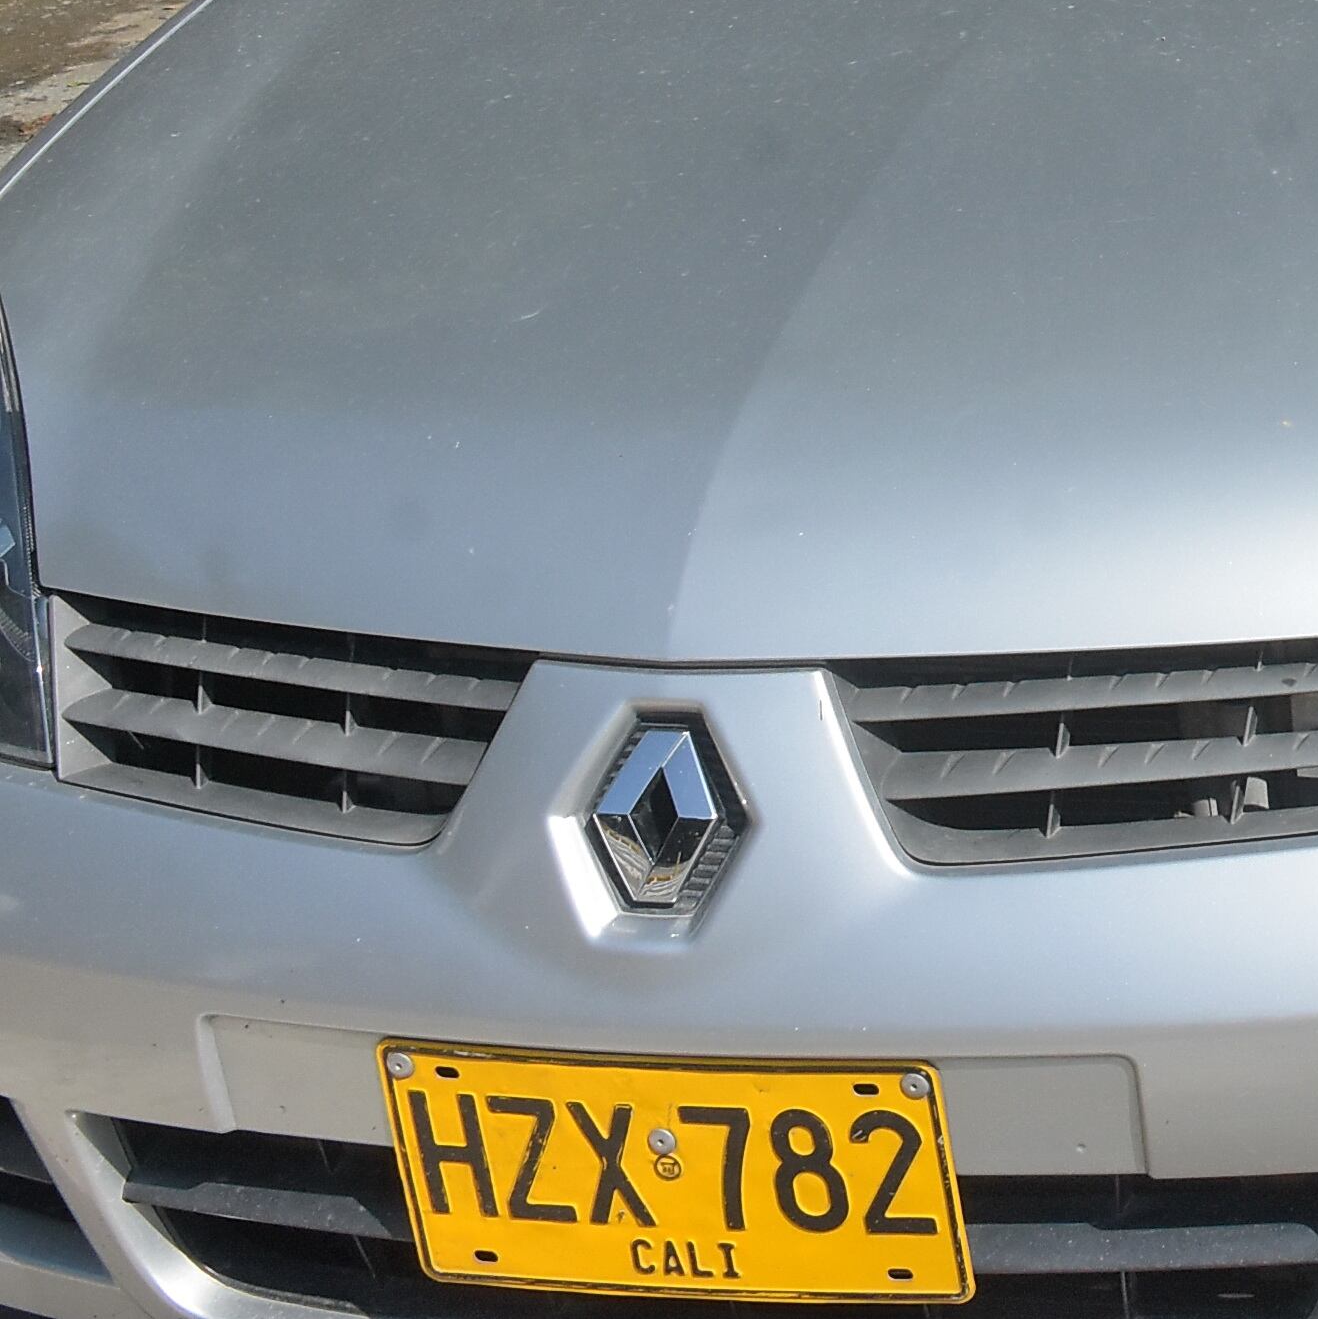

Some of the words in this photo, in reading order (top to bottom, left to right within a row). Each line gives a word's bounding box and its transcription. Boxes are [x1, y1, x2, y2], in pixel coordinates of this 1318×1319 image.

[406, 1089, 656, 1228] HZX
[678, 1105, 939, 1236] 782
[630, 1239, 741, 1279] CALI
